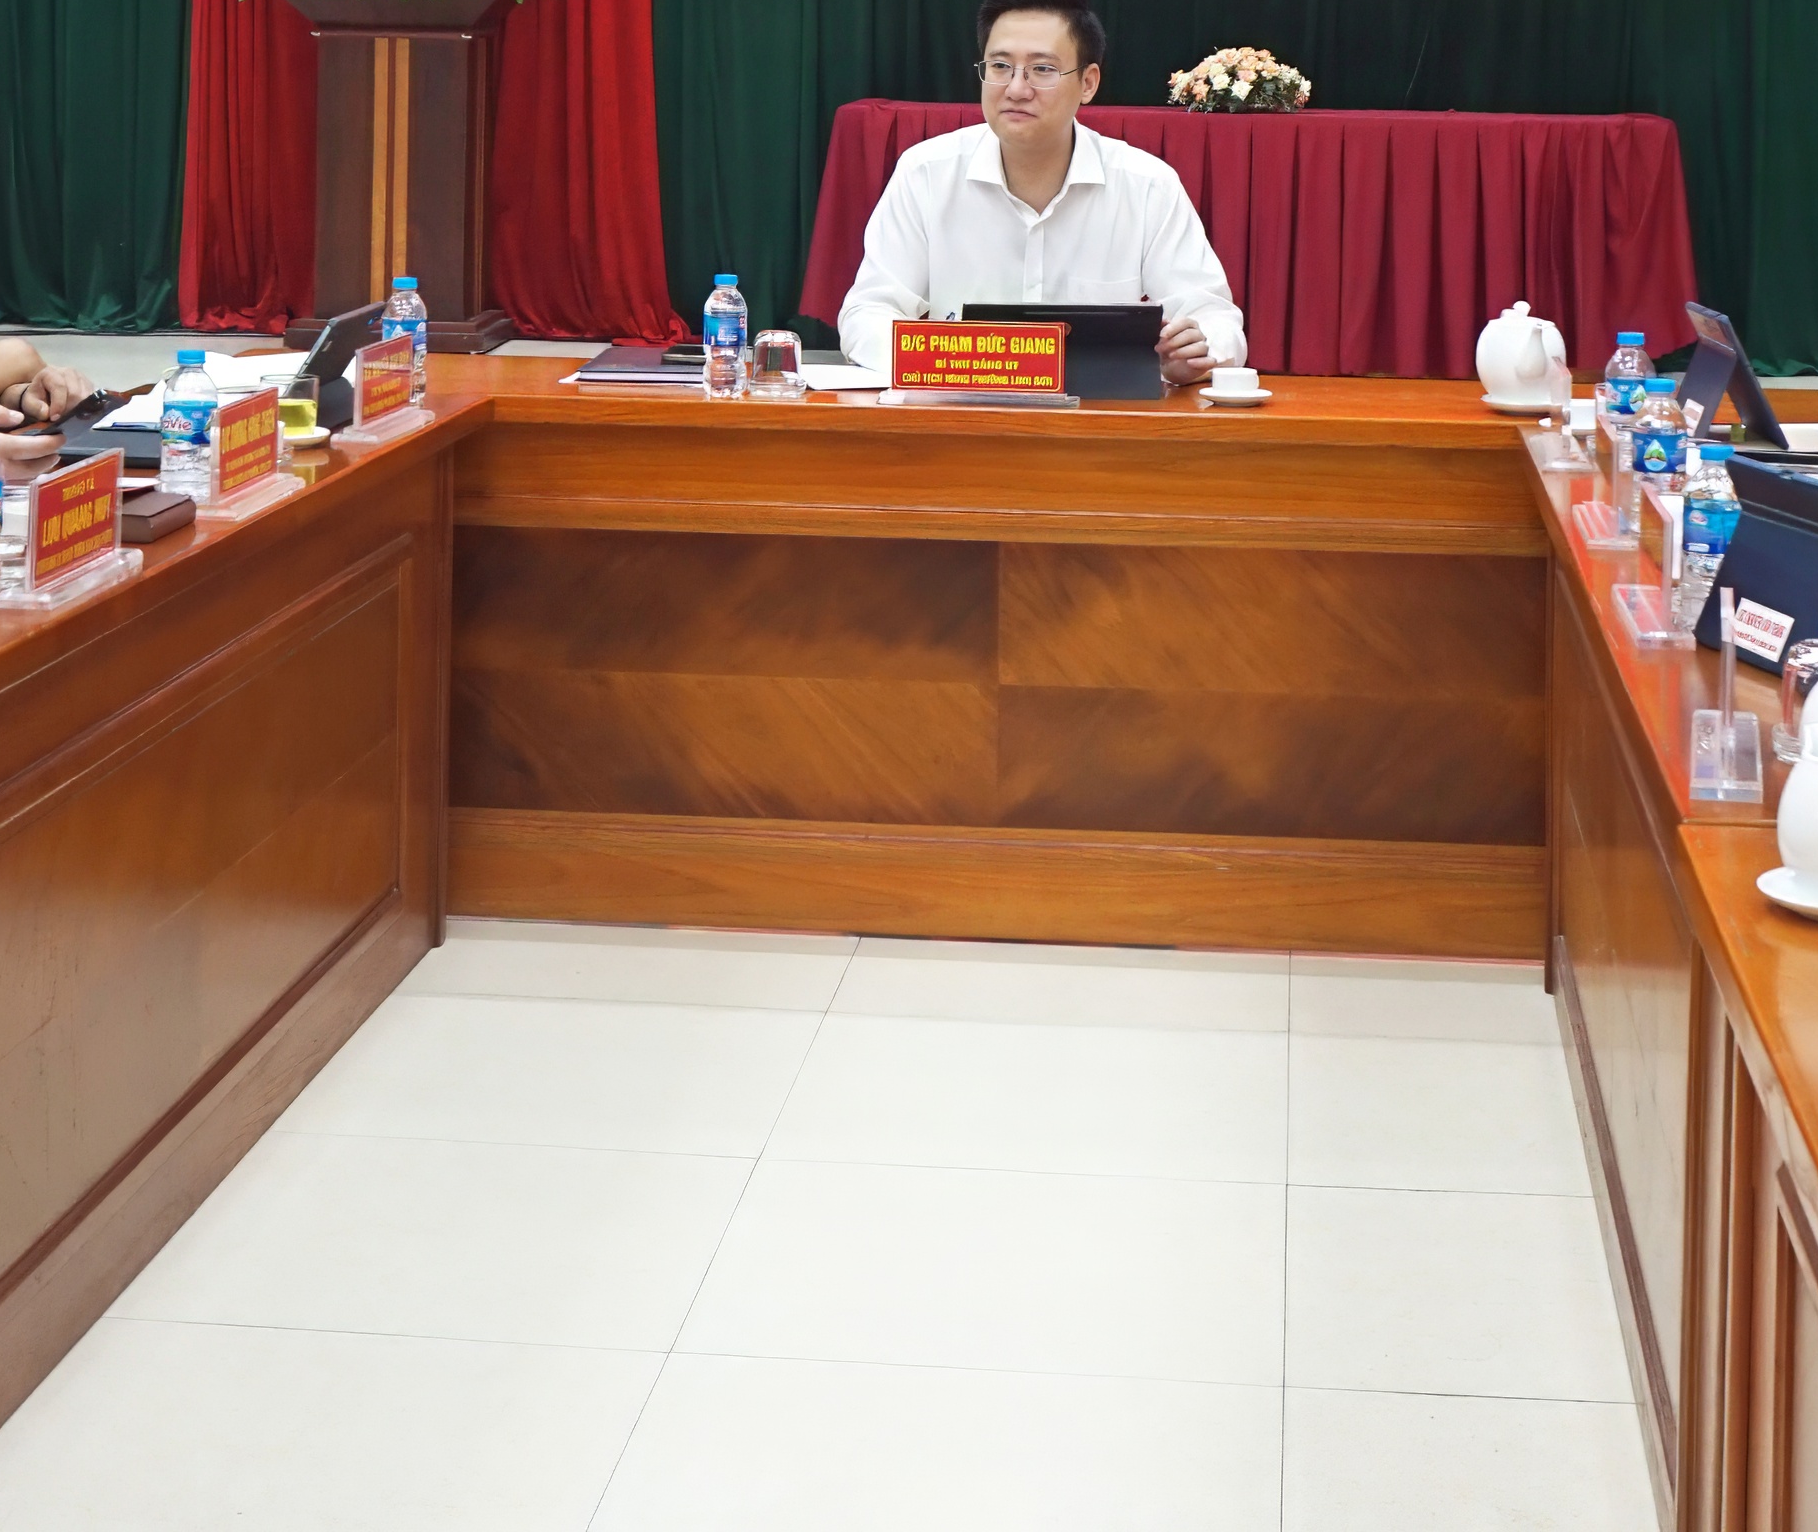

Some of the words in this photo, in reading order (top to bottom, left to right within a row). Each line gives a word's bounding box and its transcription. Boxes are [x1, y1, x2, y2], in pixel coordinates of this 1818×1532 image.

[901, 334, 926, 352] Đ/C
[929, 335, 973, 355] PHẠM
[976, 332, 1007, 353] ĐỨC
[1010, 336, 1056, 356] GIANG
